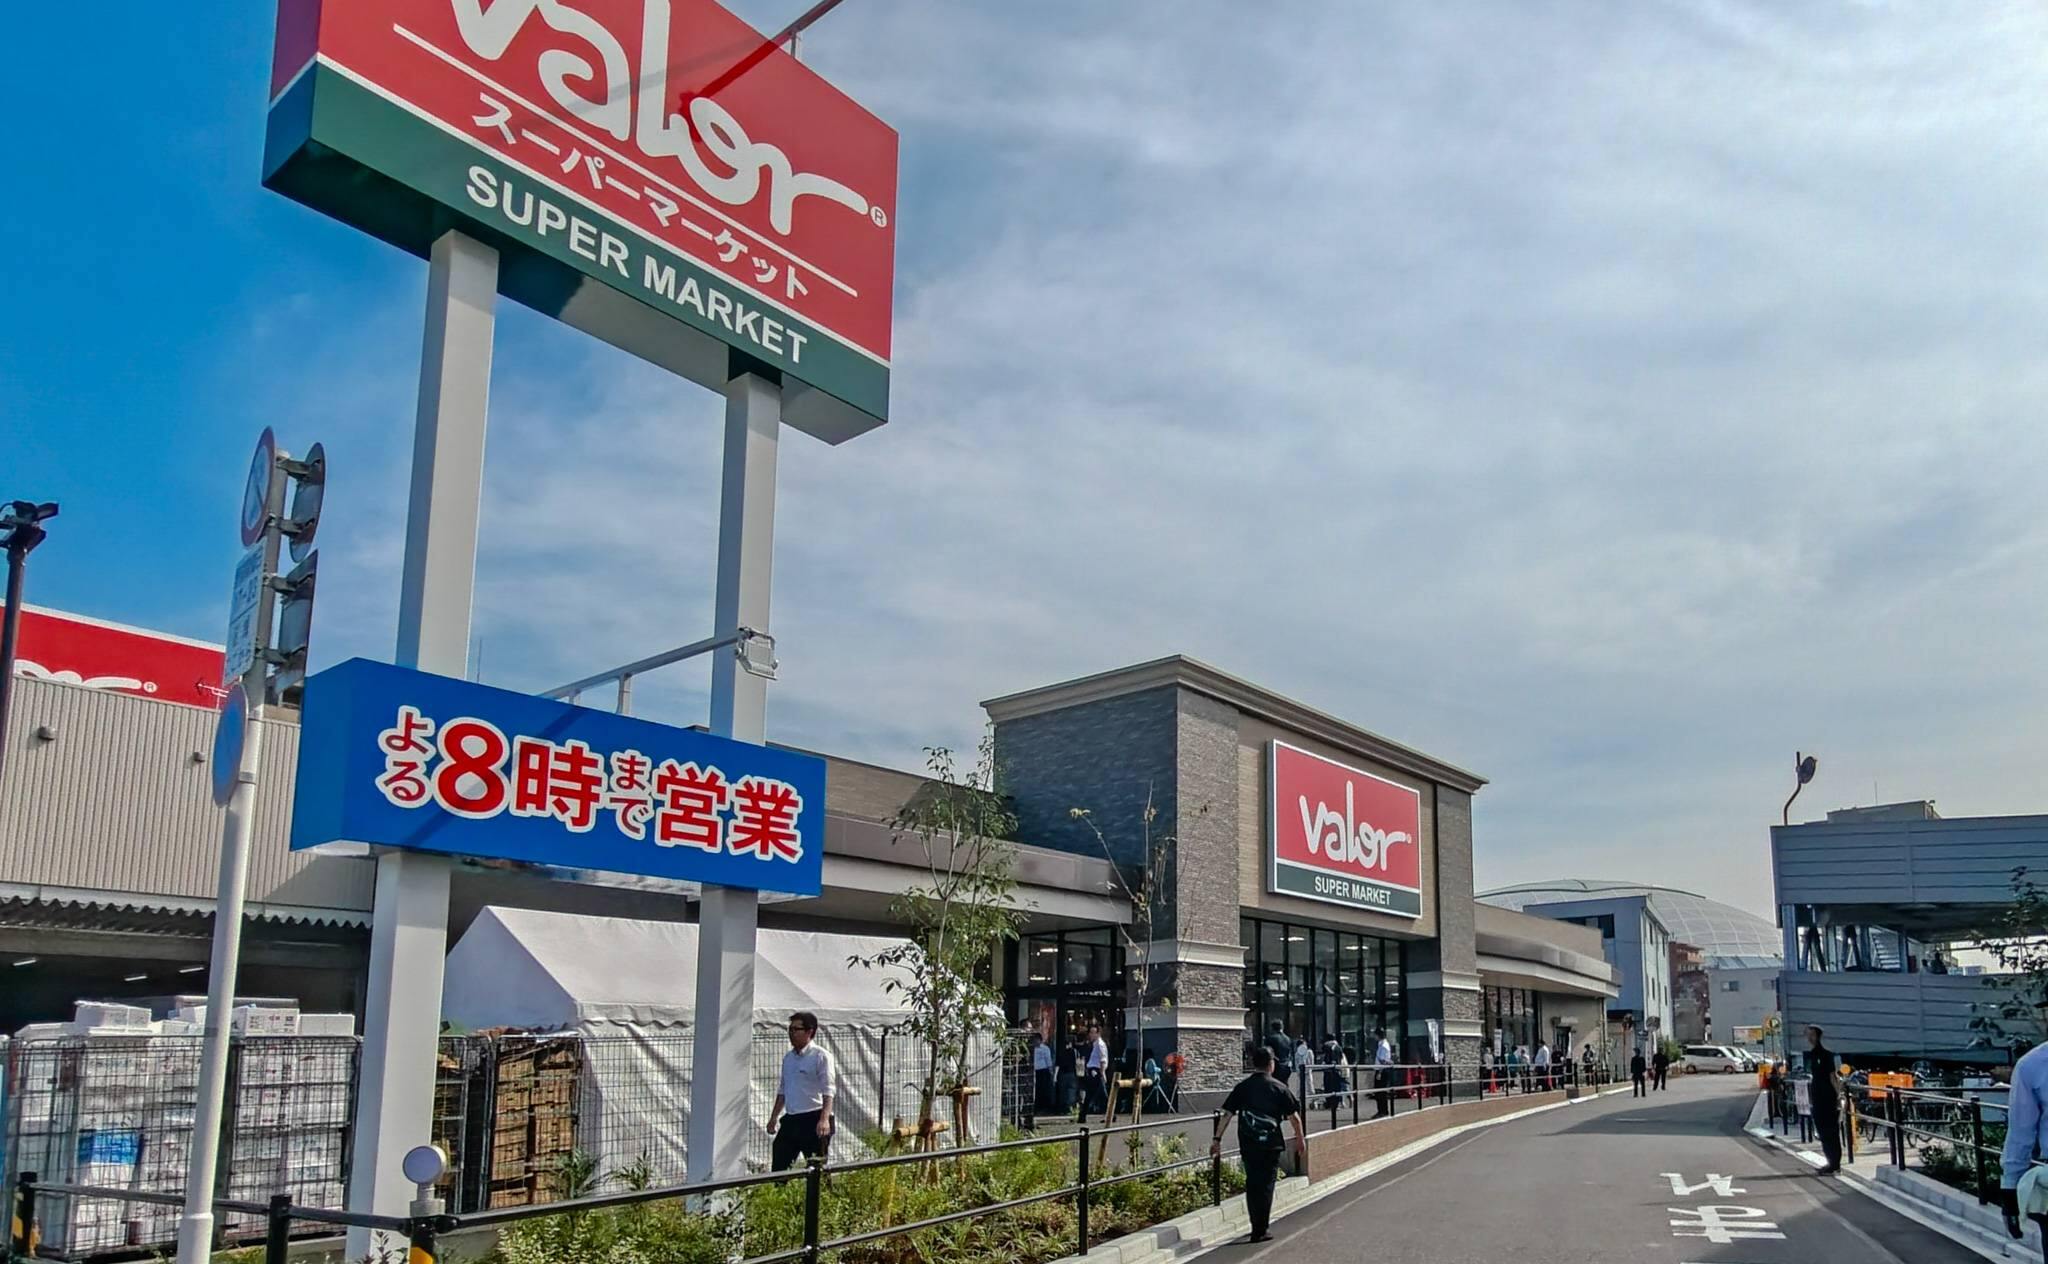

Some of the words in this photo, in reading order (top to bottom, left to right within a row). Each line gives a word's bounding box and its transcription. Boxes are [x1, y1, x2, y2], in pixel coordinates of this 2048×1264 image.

[465, 165, 629, 279] SUPER
[644, 254, 808, 364] MARKET
[471, 92, 809, 299] スーパーマーケット
[1314, 876, 1350, 898] SUPER
[1352, 883, 1391, 905] MARKET
